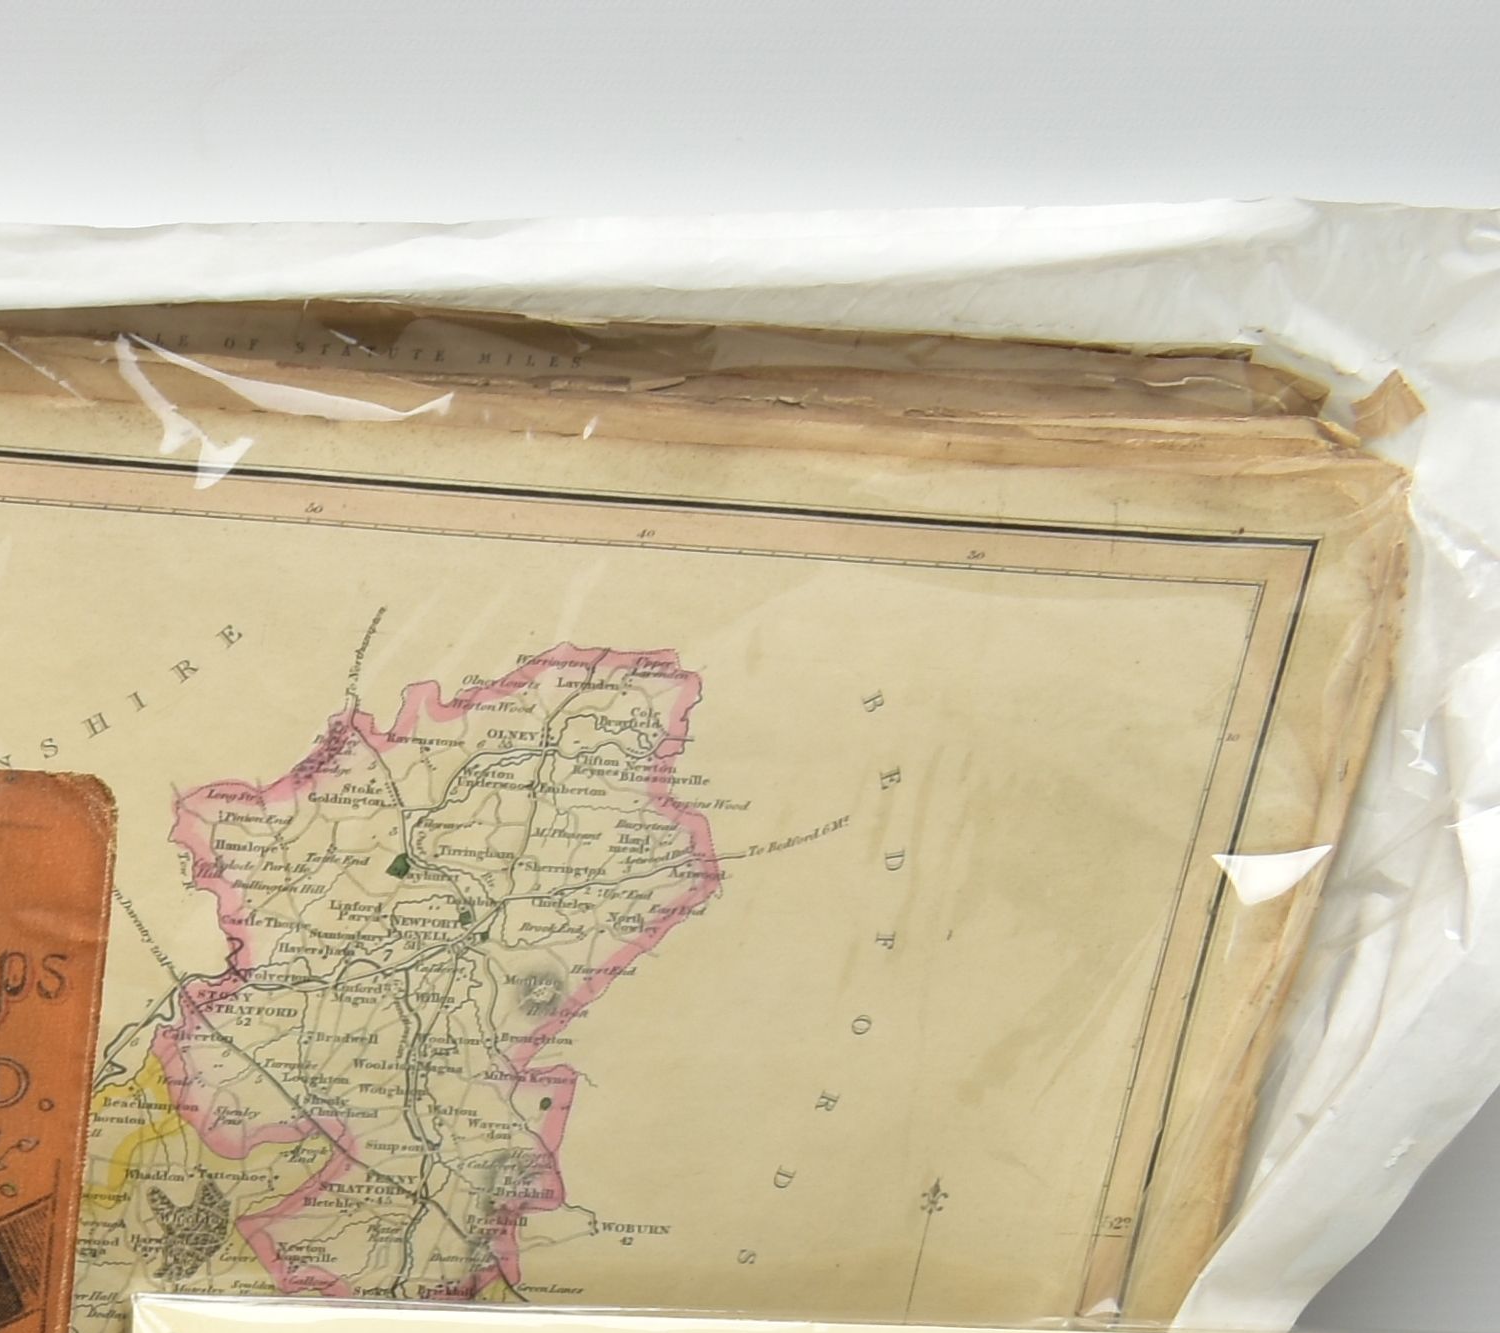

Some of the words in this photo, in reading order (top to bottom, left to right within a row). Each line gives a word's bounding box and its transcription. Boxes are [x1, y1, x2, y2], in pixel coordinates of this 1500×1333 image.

[487, 729, 539, 741] OLNEY
[539, 784, 606, 797] Emberton
[215, 841, 277, 853] Hanslope
[525, 862, 606, 876] Sherrington
[206, 1005, 298, 1019] STRATFORD
[602, 1223, 670, 1236] WOBURN
